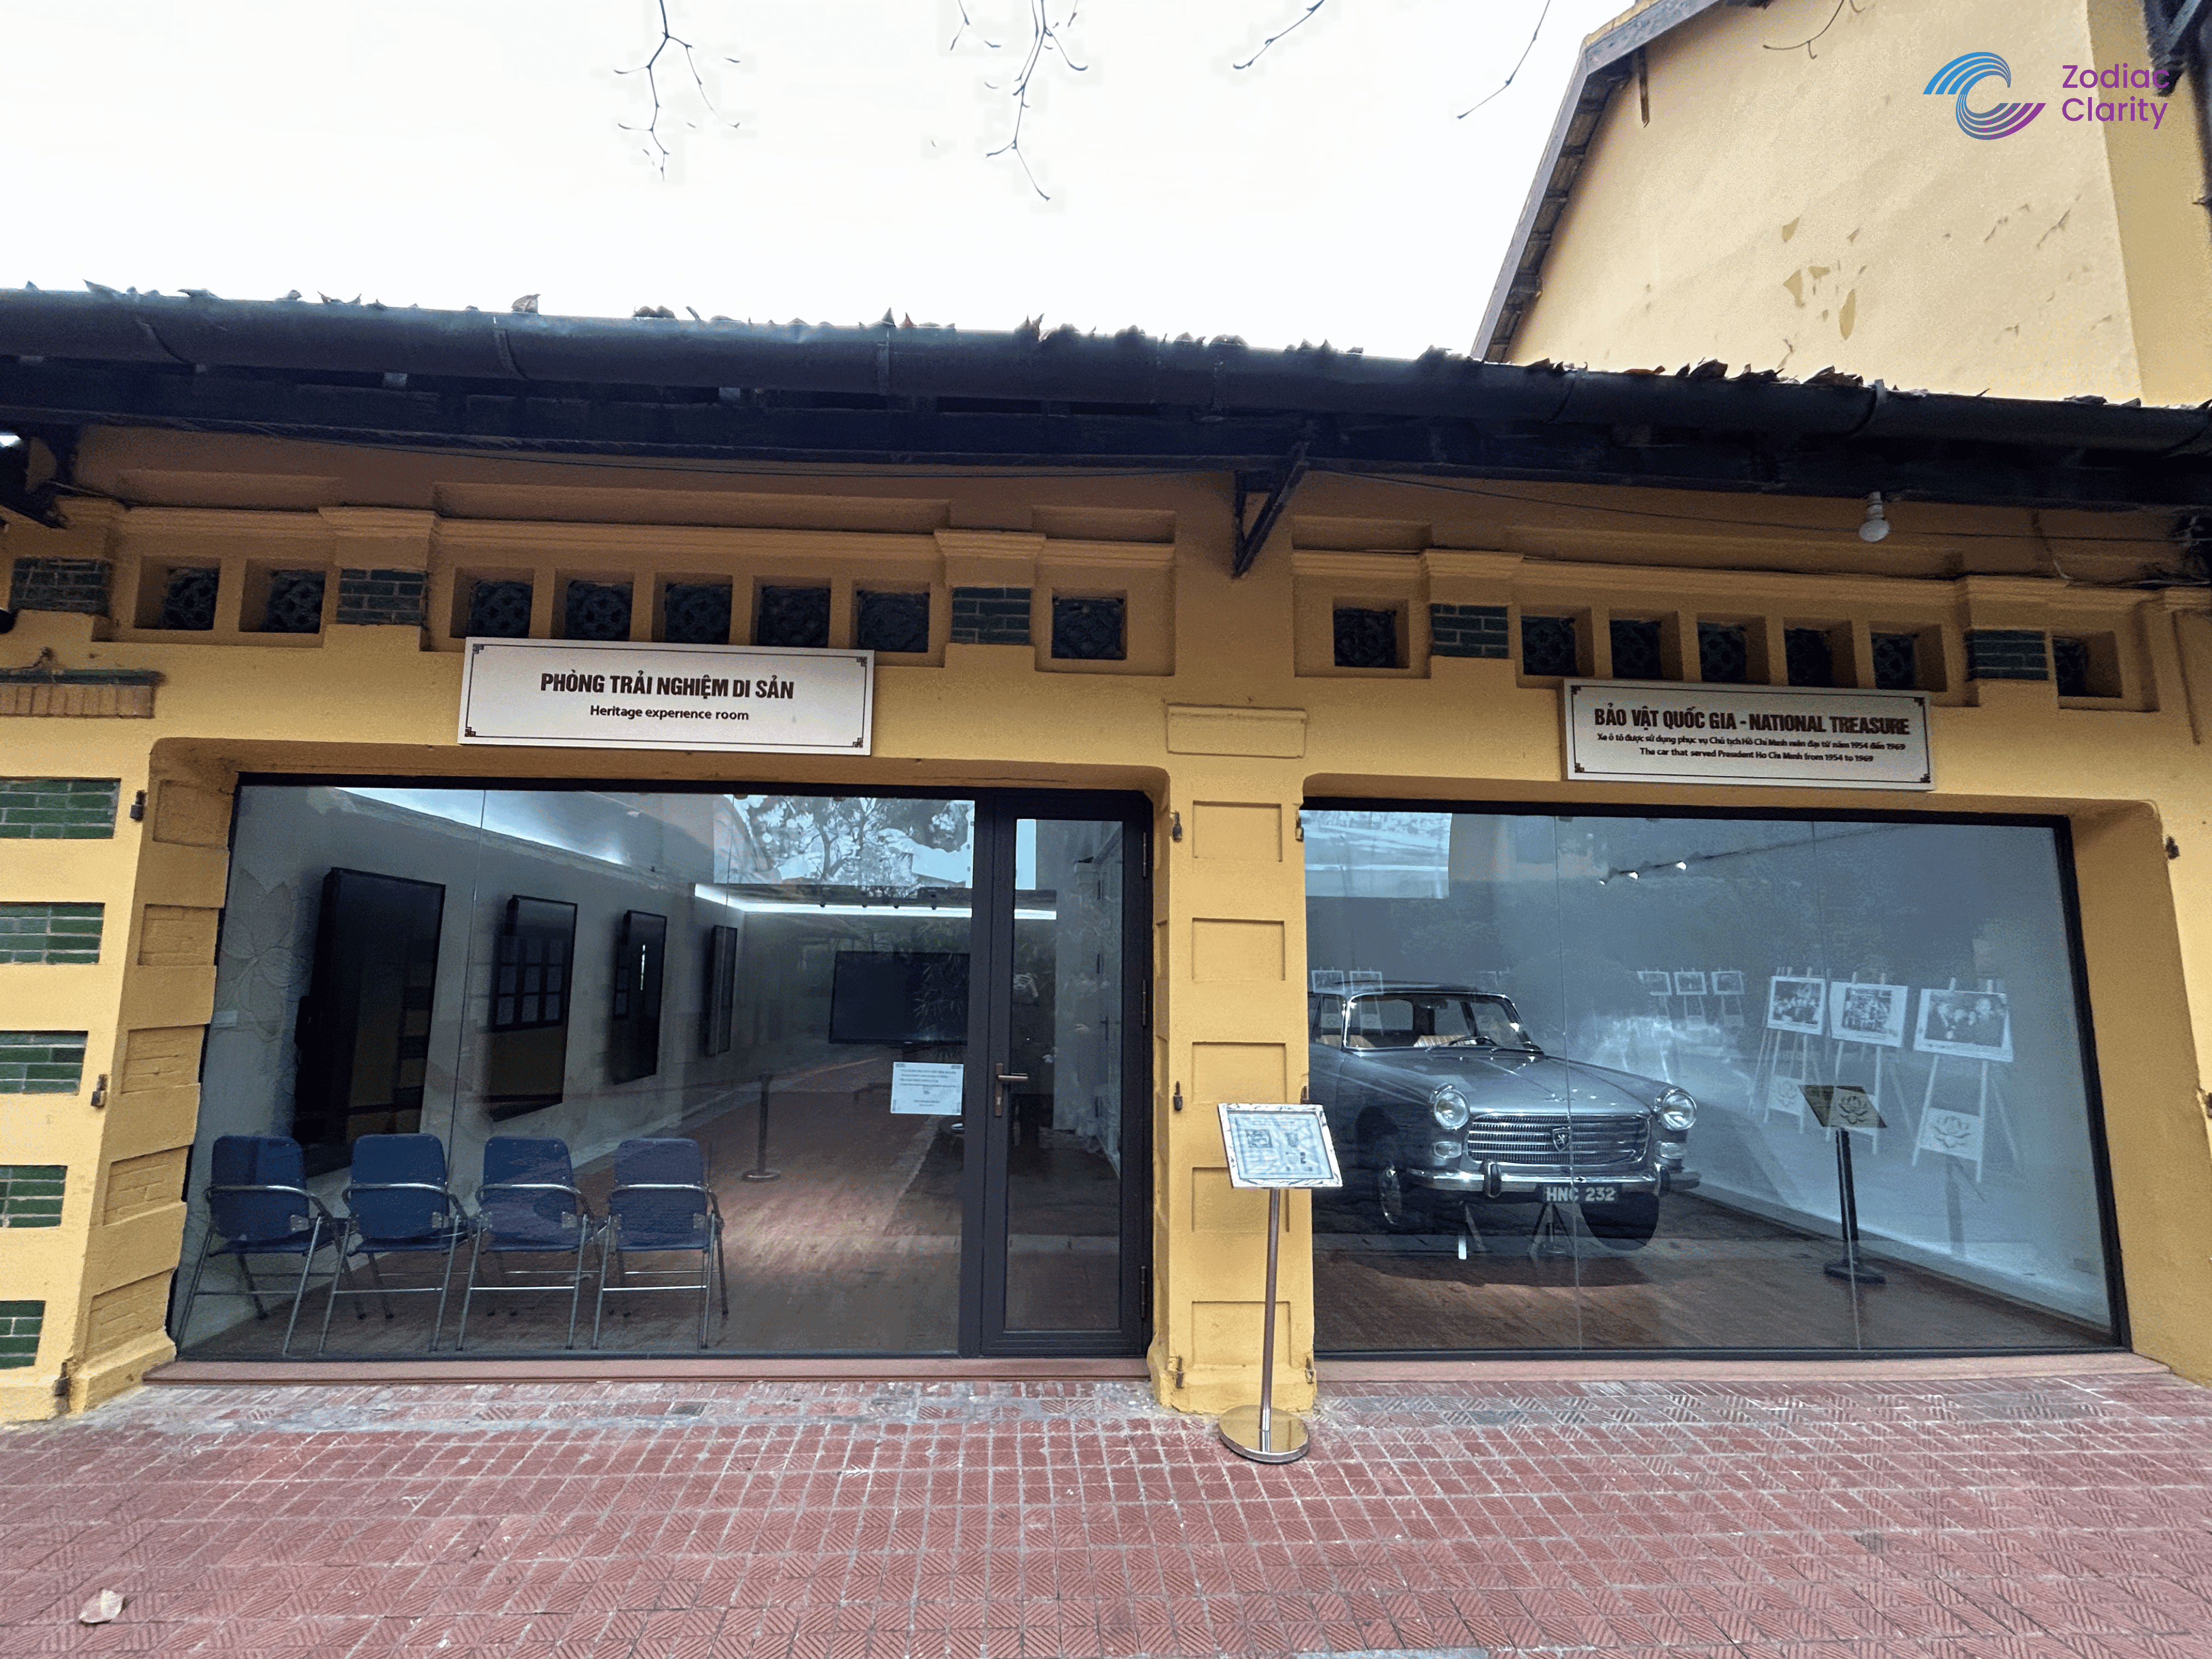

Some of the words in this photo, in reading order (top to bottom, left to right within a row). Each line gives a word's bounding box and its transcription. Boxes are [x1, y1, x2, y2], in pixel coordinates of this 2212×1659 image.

[540, 669, 605, 693] PHÒNG
[610, 670, 653, 695] TRẢI
[656, 674, 729, 699] NGHIỆM
[732, 679, 751, 698] DI
[755, 675, 794, 699] SẢN
[590, 704, 643, 720] Heritage
[645, 708, 712, 720] experience
[715, 711, 749, 720] room
[1594, 702, 1627, 726] BẢO
[1631, 706, 1659, 731] VẬT
[1662, 706, 1706, 730] QUỐC
[1708, 712, 1737, 730] GIA
[1748, 713, 1827, 733] NATIONAL
[1829, 716, 1911, 735] TREASURE
[1624, 733, 1644, 743] được
[1656, 735, 1677, 744] dụng
[1678, 736, 1696, 745] phục
[1698, 737, 1708, 746] vụ
[1709, 736, 1725, 744] Chủ
[1726, 737, 1741, 747] tịch
[1754, 737, 1768, 746] Chí
[1639, 747, 1656, 755] The
[1718, 749, 1755, 758] President
[1768, 751, 1781, 759] Chi
[1782, 752, 1803, 760] Minh
[1546, 1187, 1579, 1201] HNC
[1585, 1187, 1616, 1201] 232
